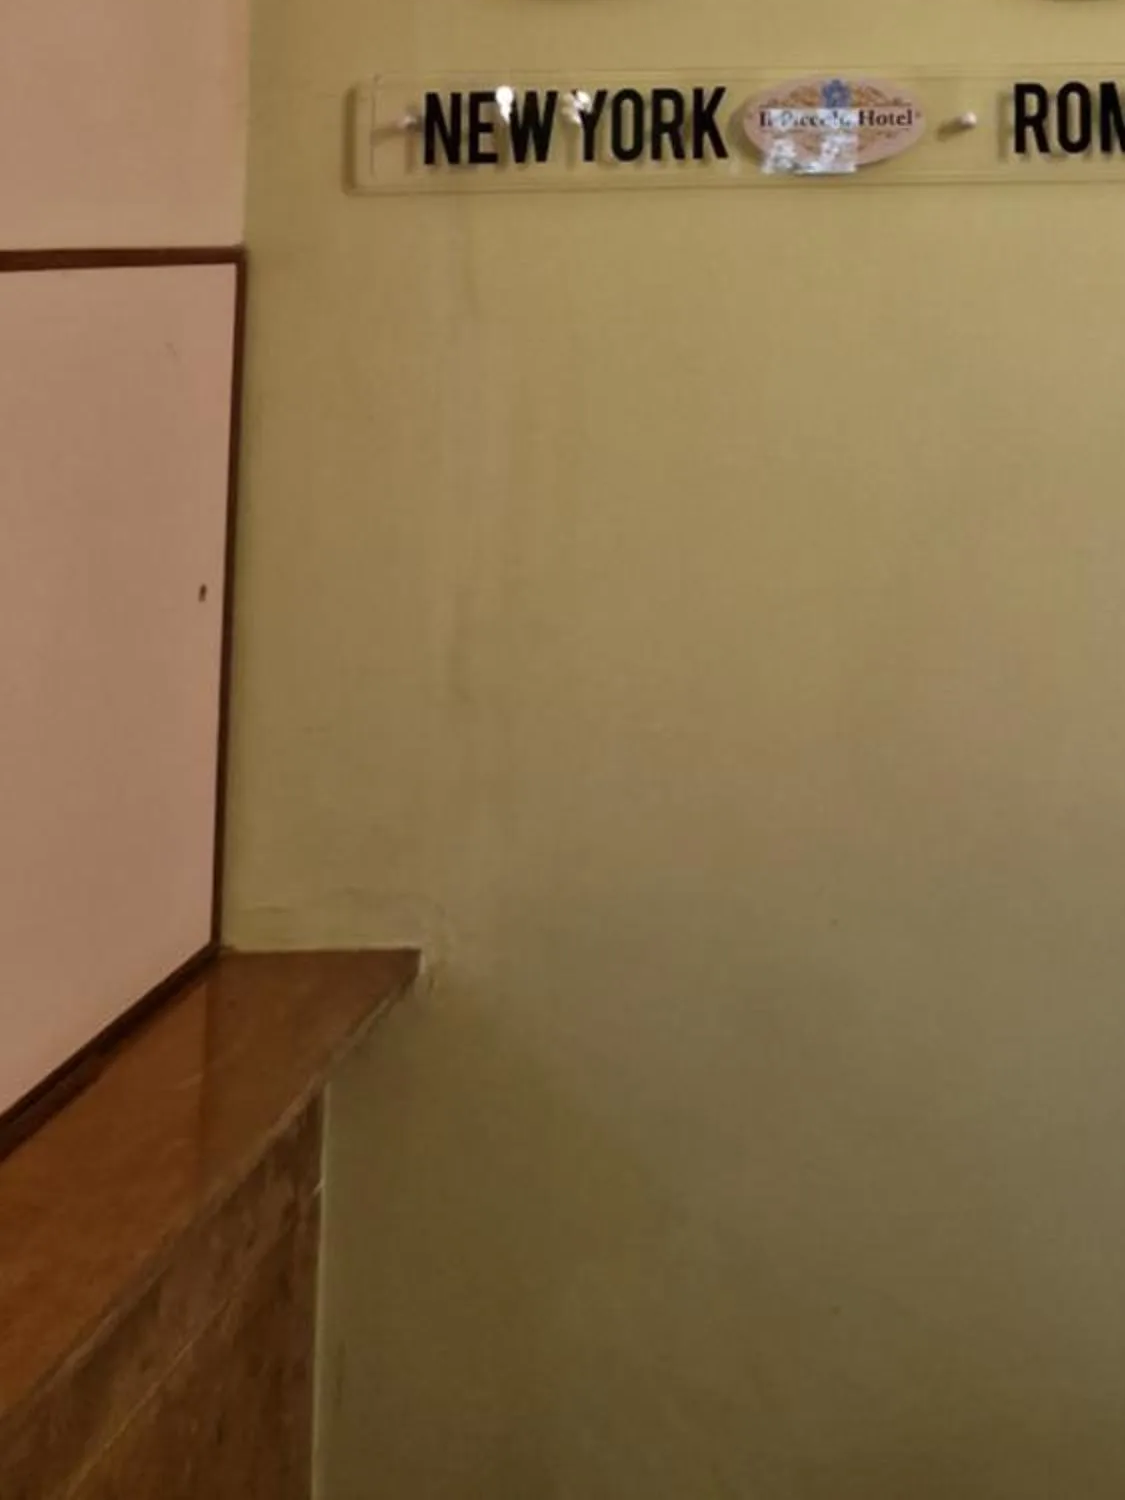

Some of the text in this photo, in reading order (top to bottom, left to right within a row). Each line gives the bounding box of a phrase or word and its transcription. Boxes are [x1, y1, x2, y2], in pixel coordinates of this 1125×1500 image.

[424, 87, 729, 164] NEW YORK
[858, 109, 913, 127] Hotel
